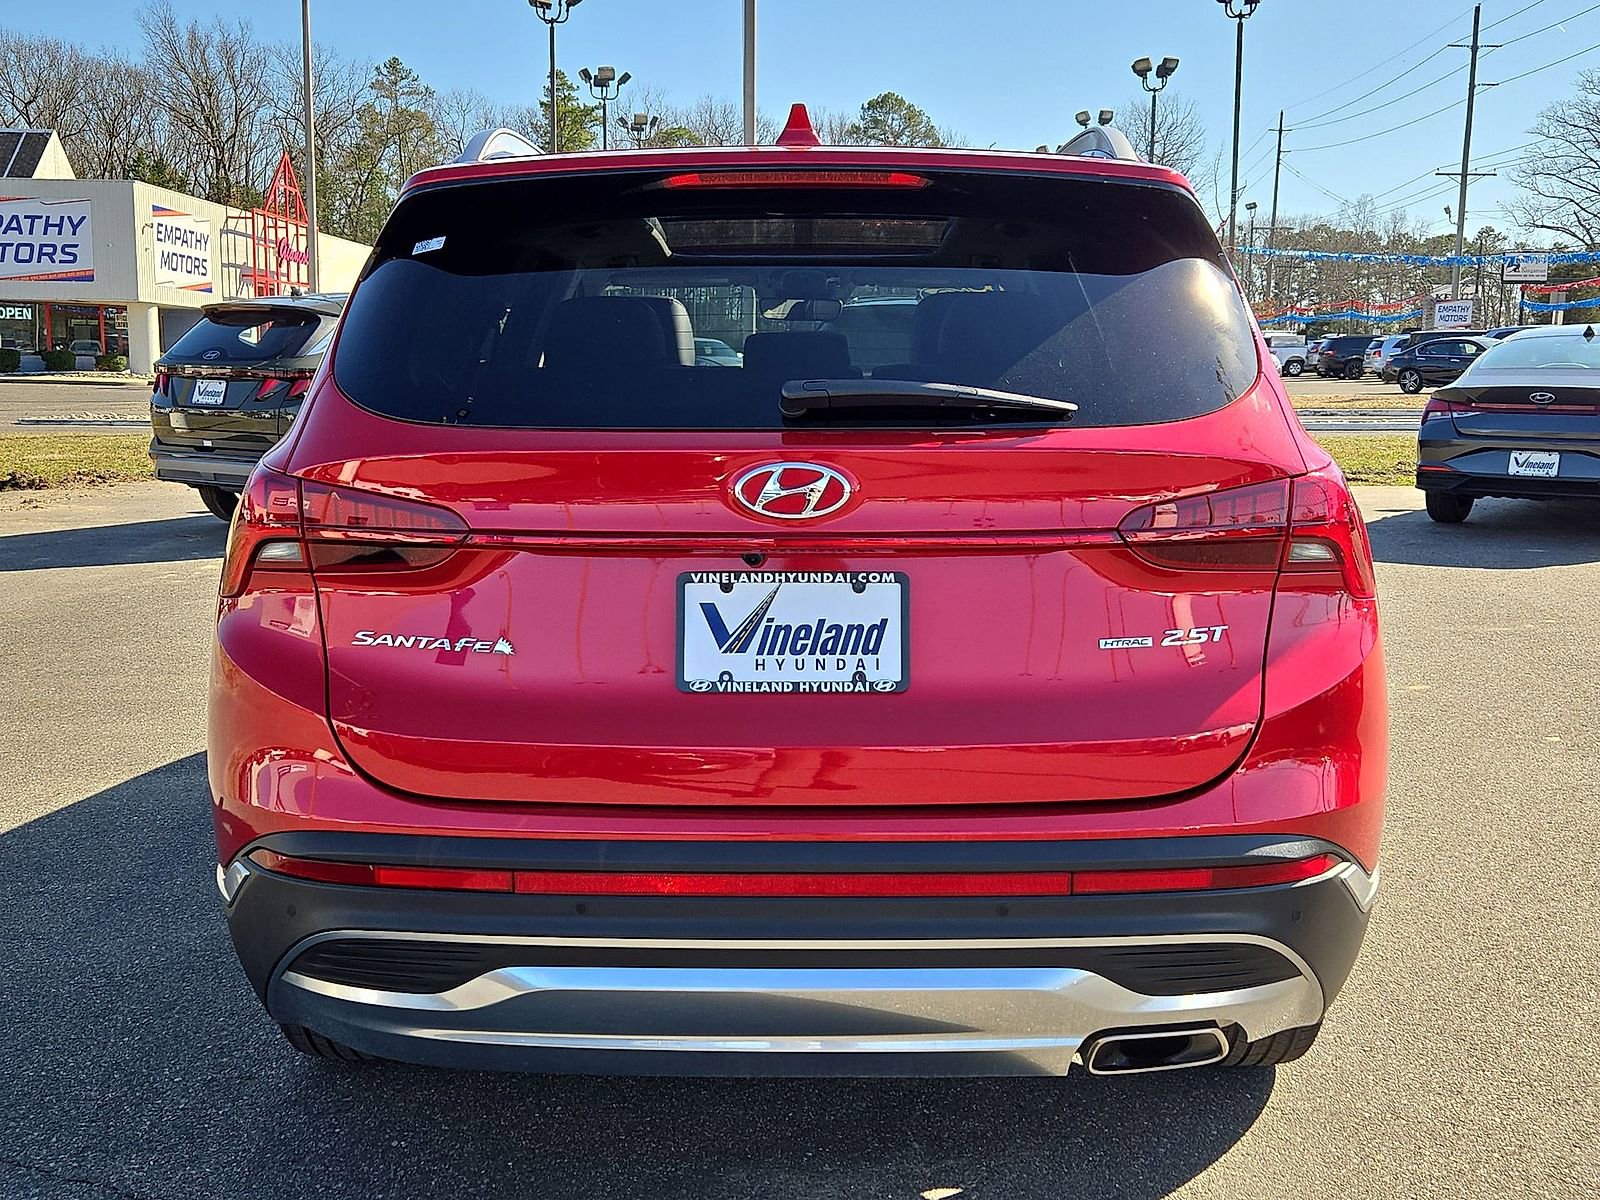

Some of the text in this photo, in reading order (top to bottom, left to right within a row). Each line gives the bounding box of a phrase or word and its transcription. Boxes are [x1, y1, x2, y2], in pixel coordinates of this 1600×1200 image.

[156, 222, 210, 252] EMPATHY
[160, 250, 208, 277] MOTORS
[0, 306, 32, 320] OPEN
[1437, 305, 1471, 314] EMPATHY
[1438, 314, 1469, 323] MOTORS
[1513, 453, 1556, 470] Vineland
[690, 572, 896, 584] VINELANDHYUNDAI.COM
[699, 582, 889, 656] Vineland
[1103, 637, 1150, 648] HTRAC
[755, 657, 881, 672] HYUNDAI
[716, 680, 870, 693] VINELAND HYUNDAI
